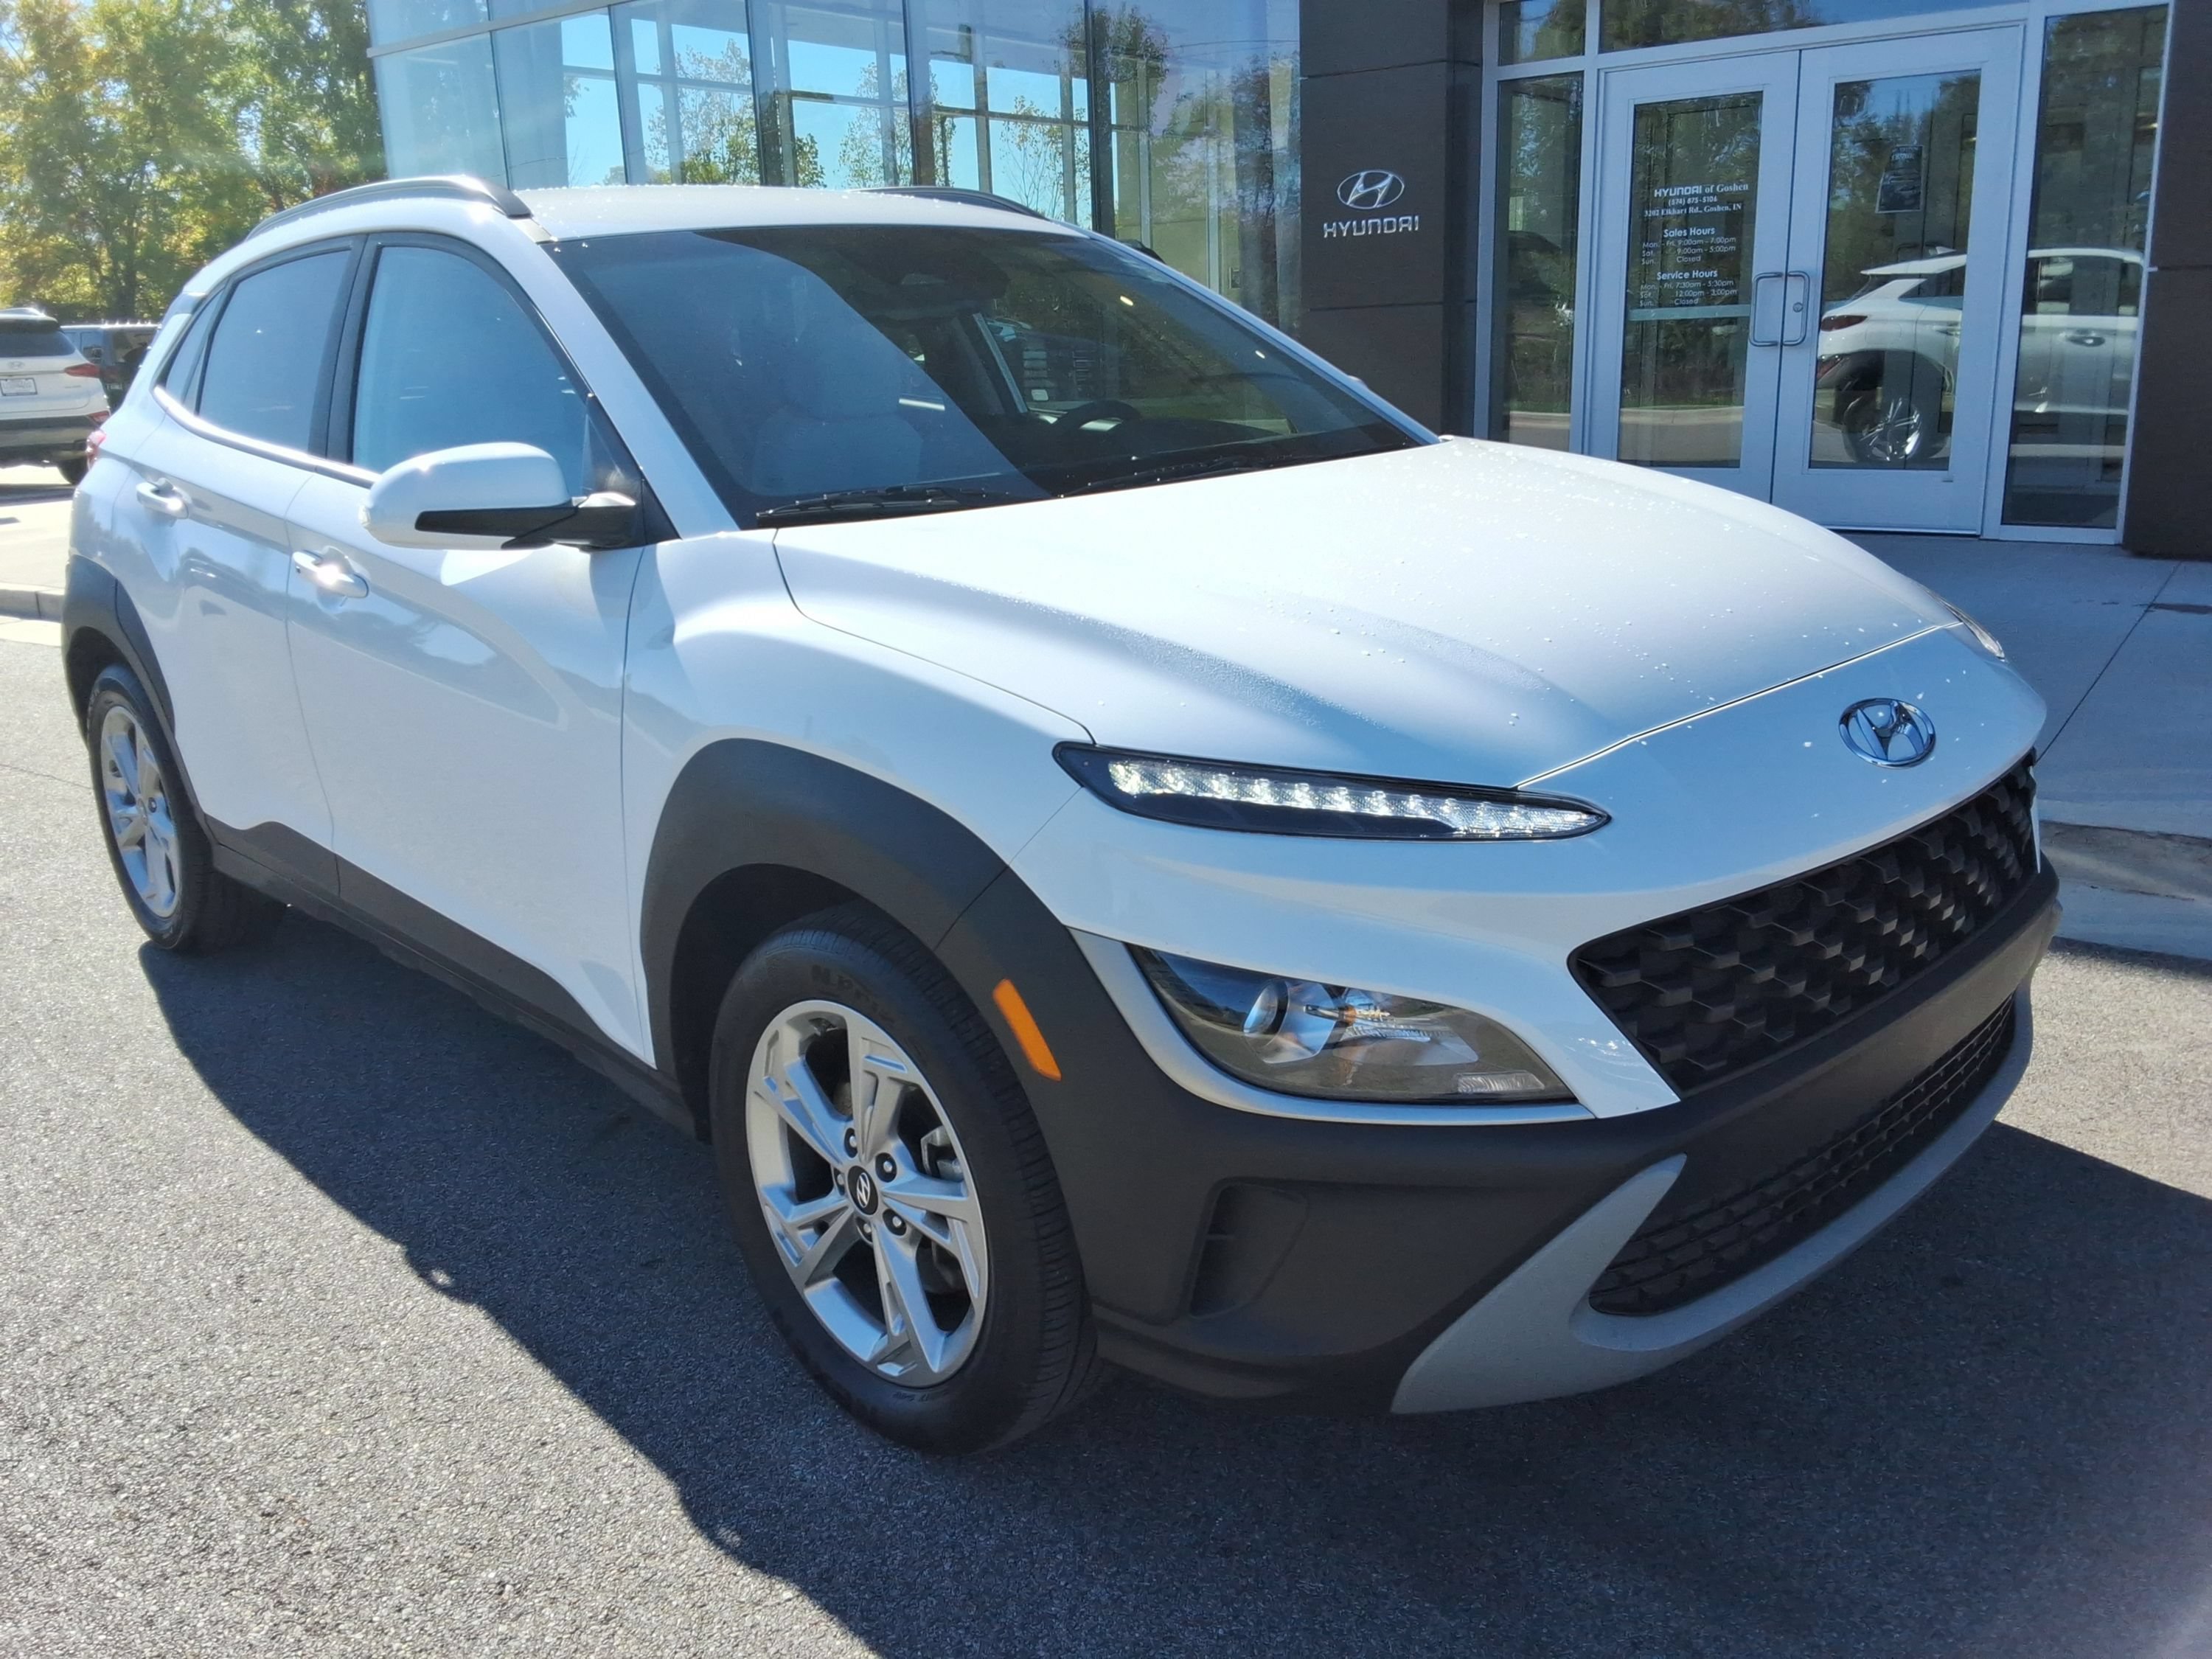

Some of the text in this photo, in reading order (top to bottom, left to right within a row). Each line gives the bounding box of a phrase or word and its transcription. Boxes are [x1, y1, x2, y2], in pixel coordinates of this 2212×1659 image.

[1654, 183, 1749, 198] HYUNDAI of Goshen
[1661, 206, 1687, 216] Elkhart
[1733, 203, 1742, 211] IN
[1324, 215, 1419, 238] HYUNDAI
[1663, 226, 1716, 237] Sales Hours
[1676, 255, 1701, 263] Closed
[1656, 270, 1718, 281] Service Hours
